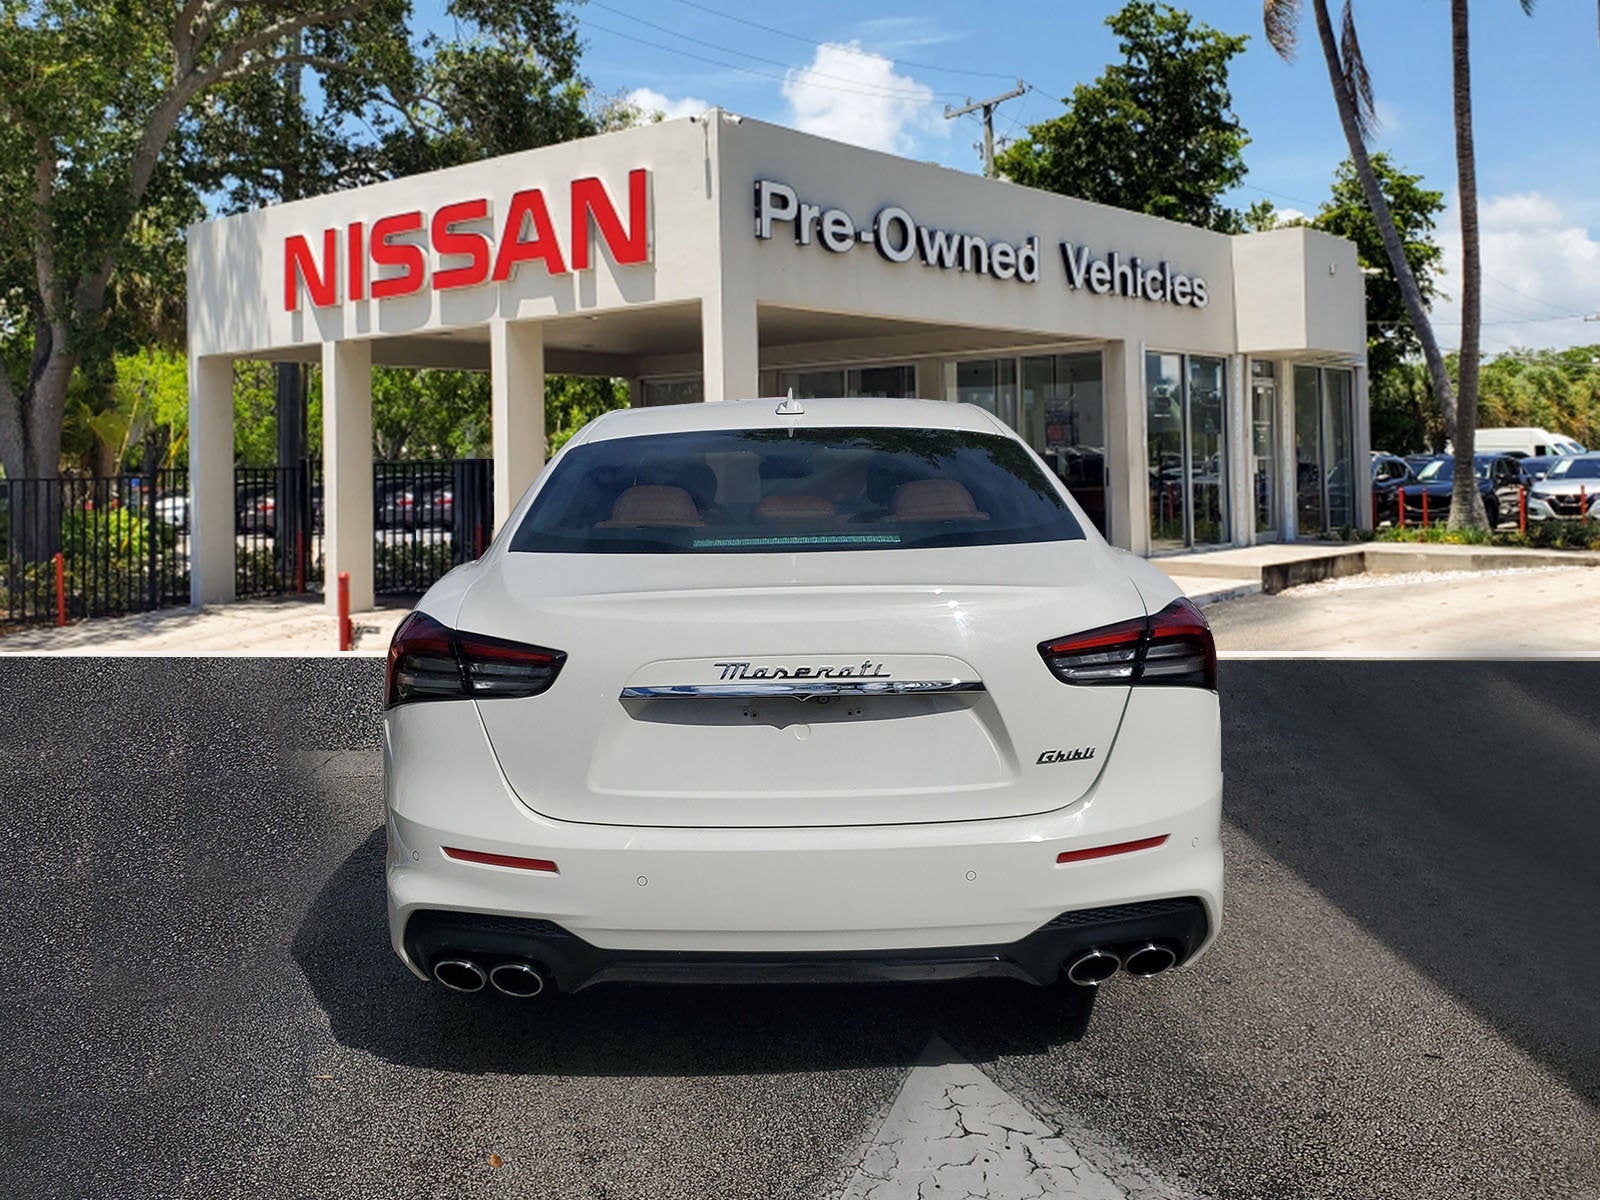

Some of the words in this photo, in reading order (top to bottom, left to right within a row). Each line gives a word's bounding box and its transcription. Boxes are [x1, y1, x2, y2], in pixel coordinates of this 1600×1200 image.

[285, 168, 649, 312] NISSAN
[755, 180, 1040, 283] Pre-Owned
[1060, 241, 1209, 308] Vehicles
[713, 659, 892, 680] Maserati
[1036, 747, 1096, 765] Ghibli
